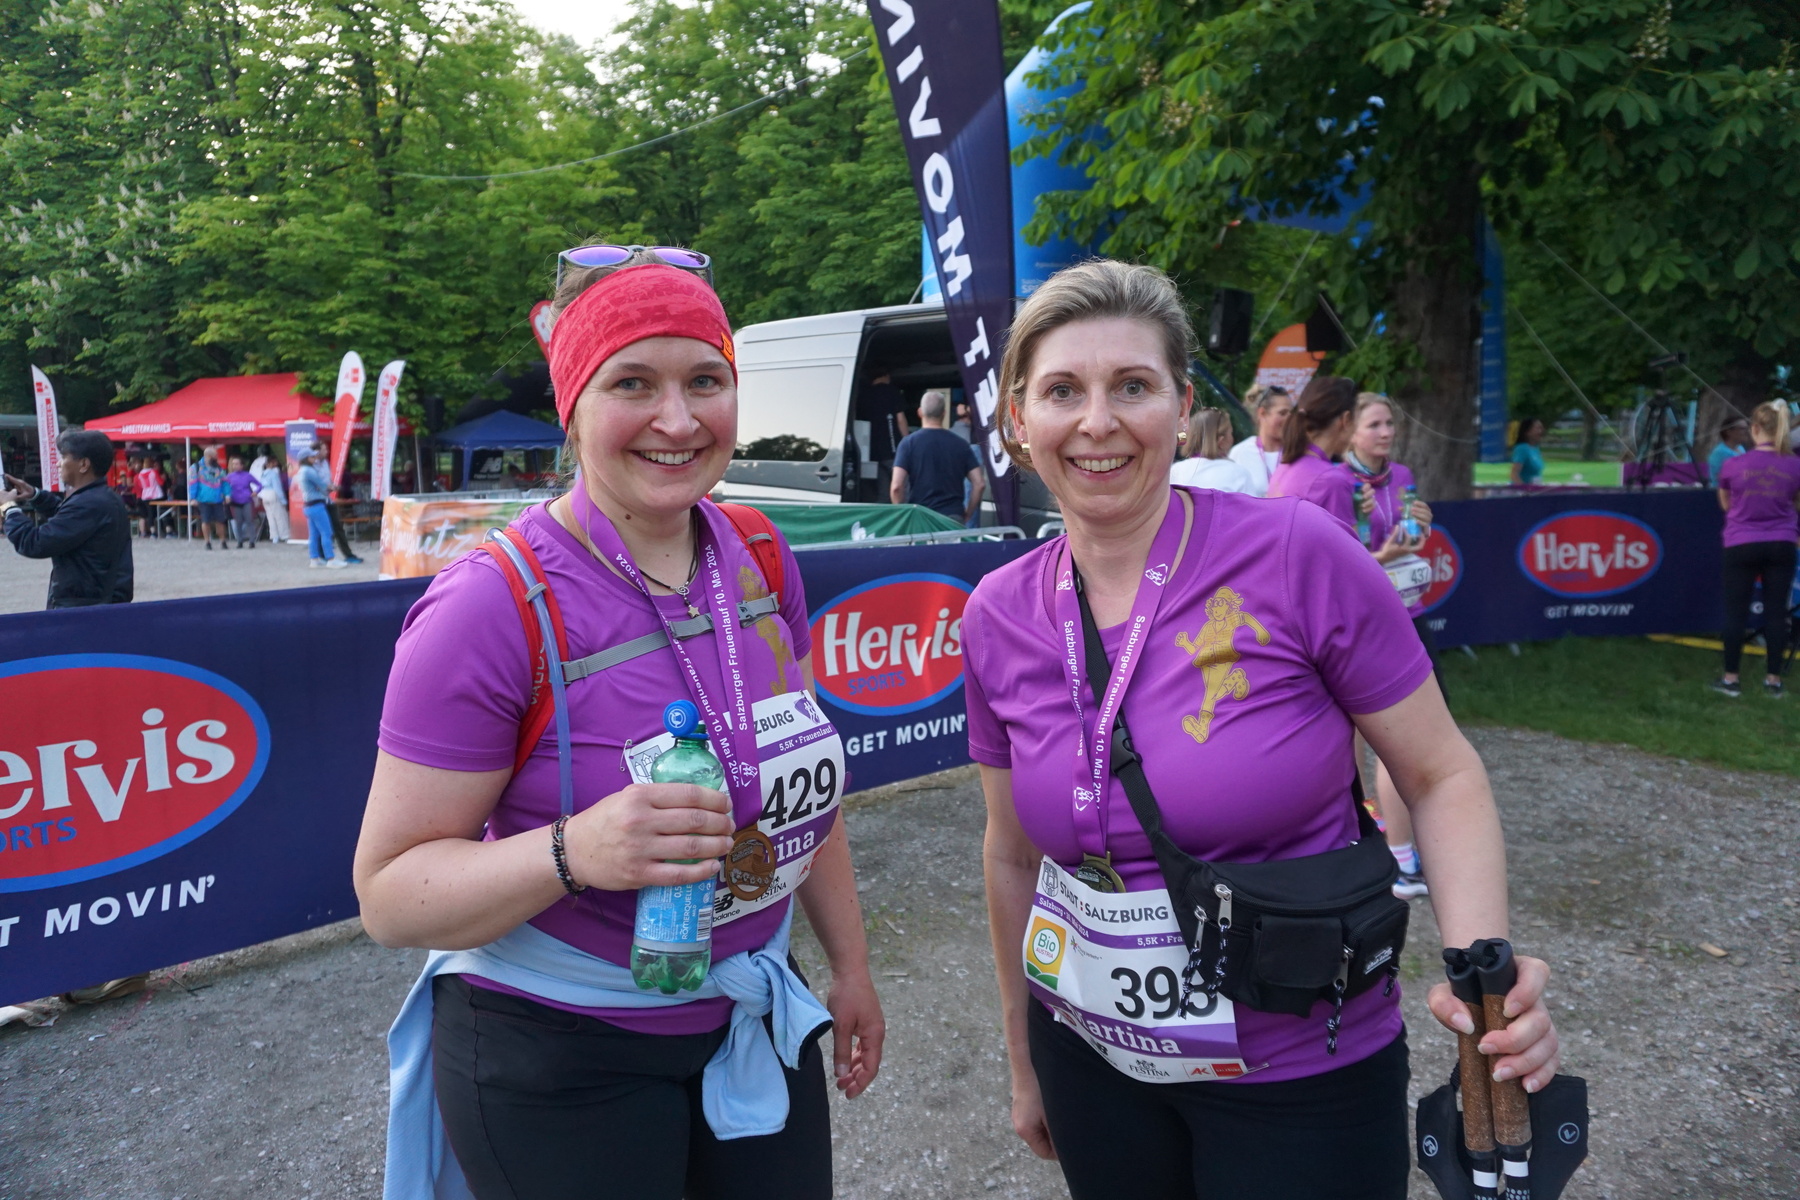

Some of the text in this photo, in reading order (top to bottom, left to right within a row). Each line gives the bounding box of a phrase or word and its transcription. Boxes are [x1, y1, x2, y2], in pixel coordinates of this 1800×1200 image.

[1534, 532, 1650, 578] Hervis
[1411, 566, 1430, 584] 437
[1544, 605, 1569, 619] GET
[705, 544, 748, 731] Salzburger Frauenlauf 10. Mai 2024
[823, 607, 962, 677] Hervis
[1064, 620, 1079, 677] Salzburger
[1119, 615, 1146, 674] Salzburger
[848, 671, 906, 695] SPORTS
[683, 657, 717, 717] Frauenlauf
[711, 718, 723, 736] 10.
[720, 737, 734, 759] Mai
[1098, 676, 1125, 736] Frauenlauf
[754, 710, 795, 734] ZBURG
[779, 725, 833, 752] 5,5K Frauenlauf
[846, 731, 888, 756] GET
[1095, 739, 1105, 755] 10.
[0, 708, 236, 823] ervis
[1093, 758, 1103, 779] Mai
[759, 758, 837, 830] 429
[1039, 897, 1064, 917] Salzburg
[1084, 903, 1169, 924] SALZBURG
[1036, 947, 1054, 959] AUSTRIA
[1038, 932, 1056, 952] Bio
[1137, 937, 1159, 946] 5,5K
[1129, 1064, 1171, 1077] FESTINA
[1191, 1067, 1211, 1076] AK
